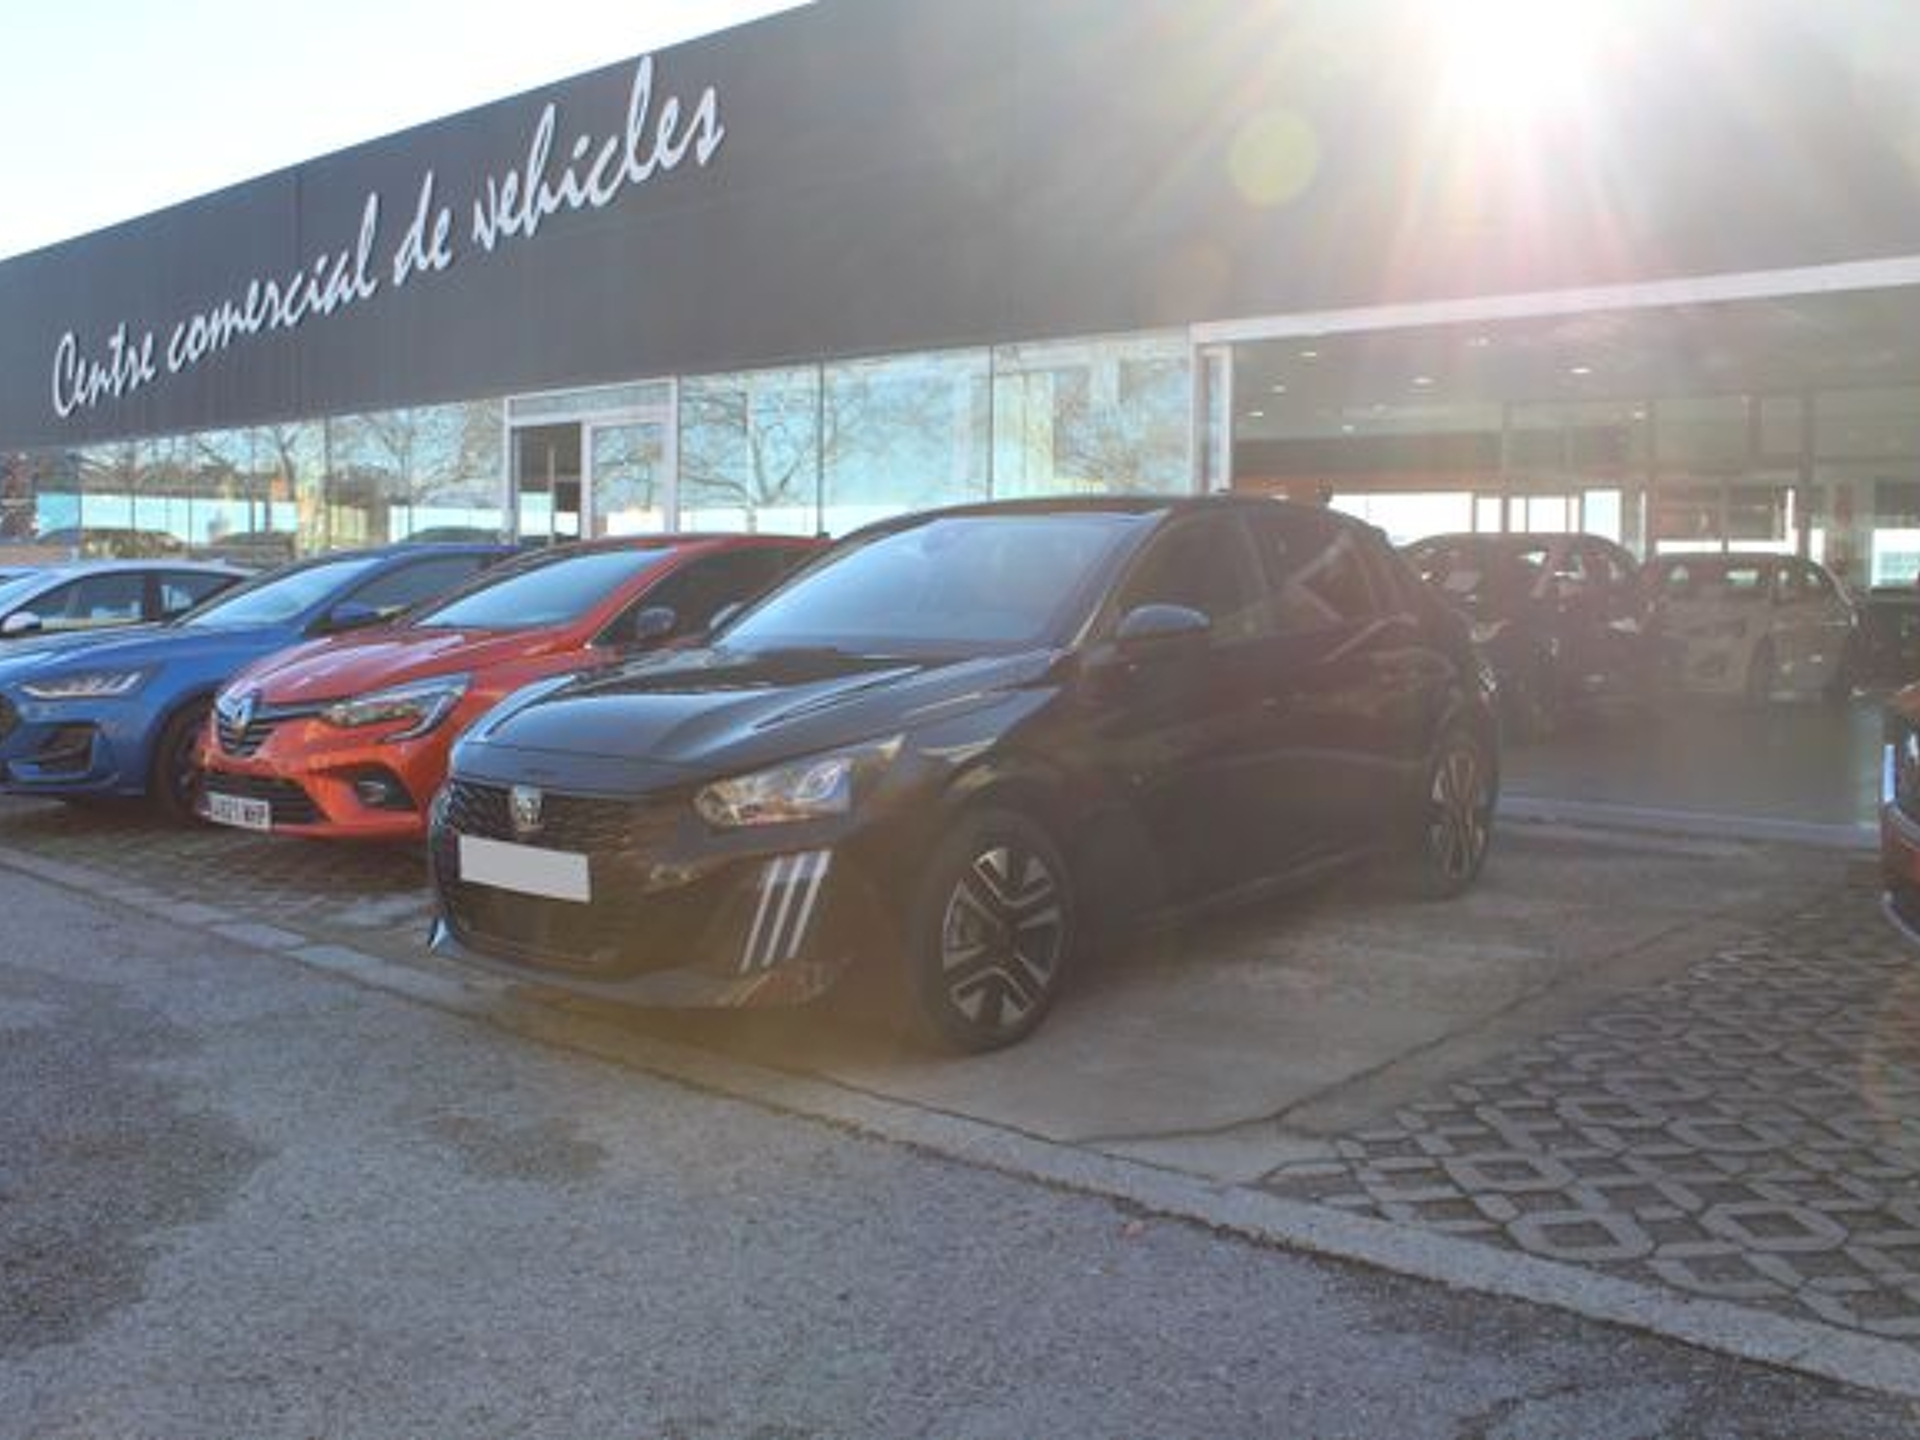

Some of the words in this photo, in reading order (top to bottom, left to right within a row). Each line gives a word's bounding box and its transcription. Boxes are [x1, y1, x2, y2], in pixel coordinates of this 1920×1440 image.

[51, 323, 156, 418] Centre
[166, 192, 378, 373] comercial
[393, 170, 452, 286] de
[472, 54, 726, 252] vehicles
